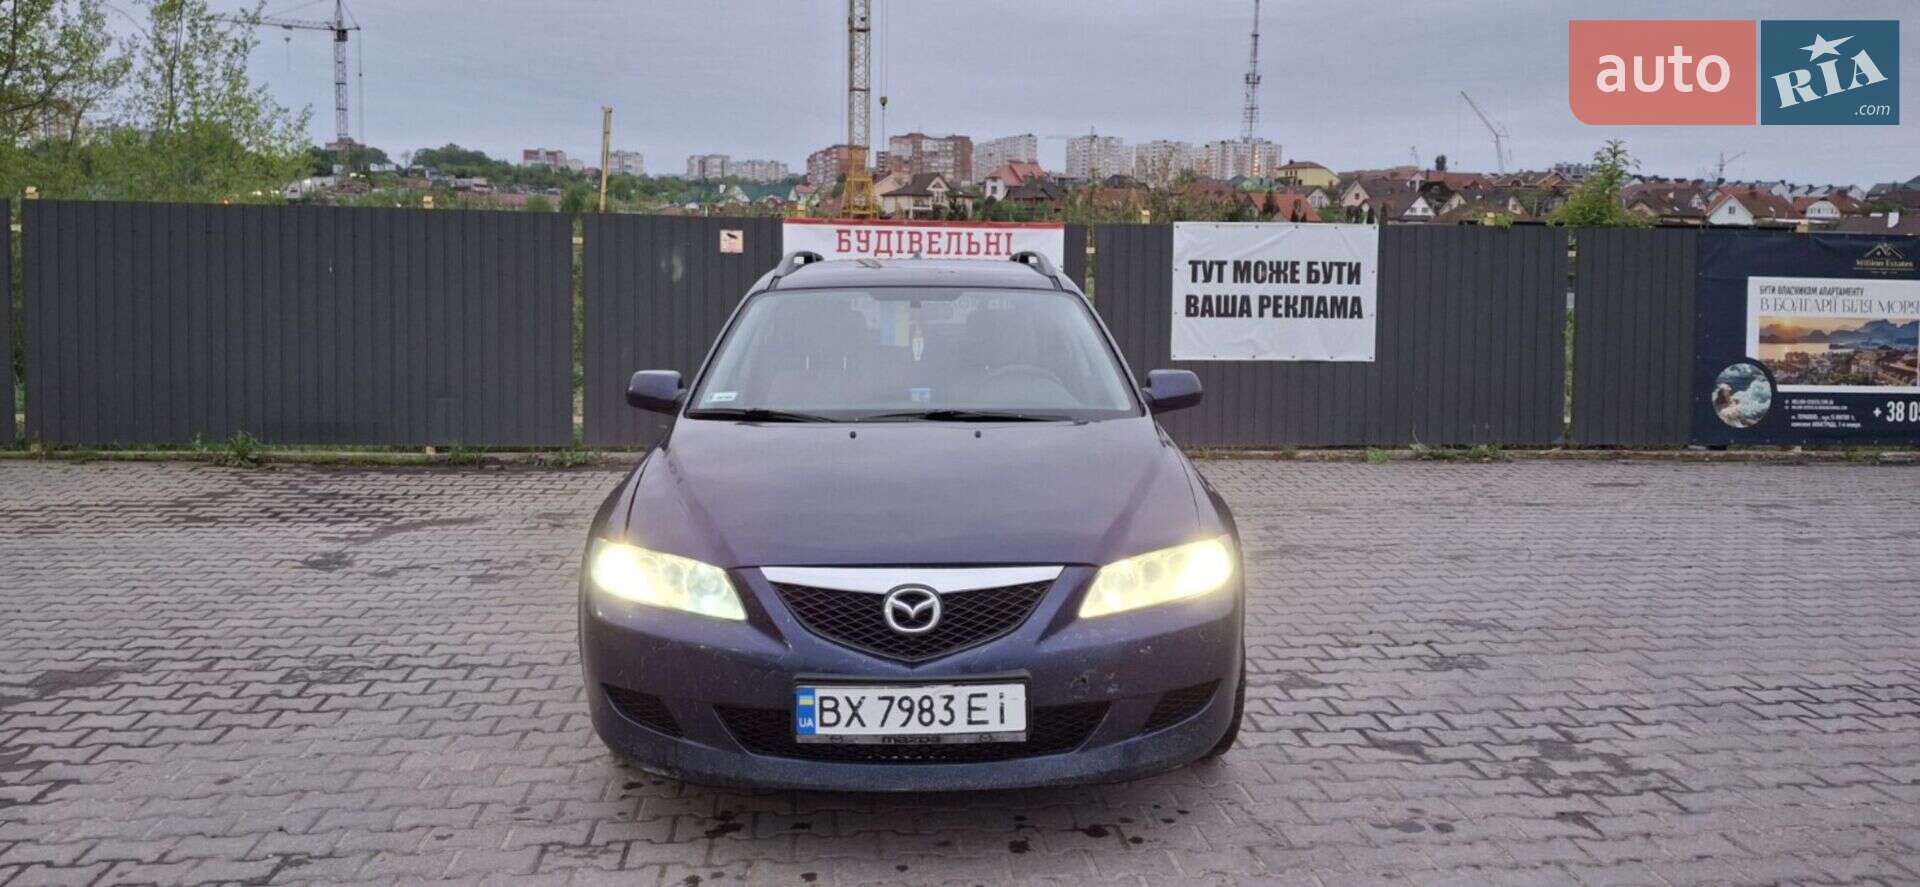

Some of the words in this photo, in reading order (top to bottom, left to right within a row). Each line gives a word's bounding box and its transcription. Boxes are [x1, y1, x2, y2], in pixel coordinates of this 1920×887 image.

[836, 229, 1013, 257] БУДІВЕЛЬНІ
[1189, 260, 1228, 283] ТУТ
[1232, 260, 1300, 284] МОЖЕ
[1306, 261, 1361, 285] БУТИ
[1185, 294, 1252, 318] ВАША
[1258, 295, 1363, 319] РЕКЛАМА
[799, 717, 814, 728] UA
[818, 695, 866, 728] BX
[877, 694, 956, 728] 7983
